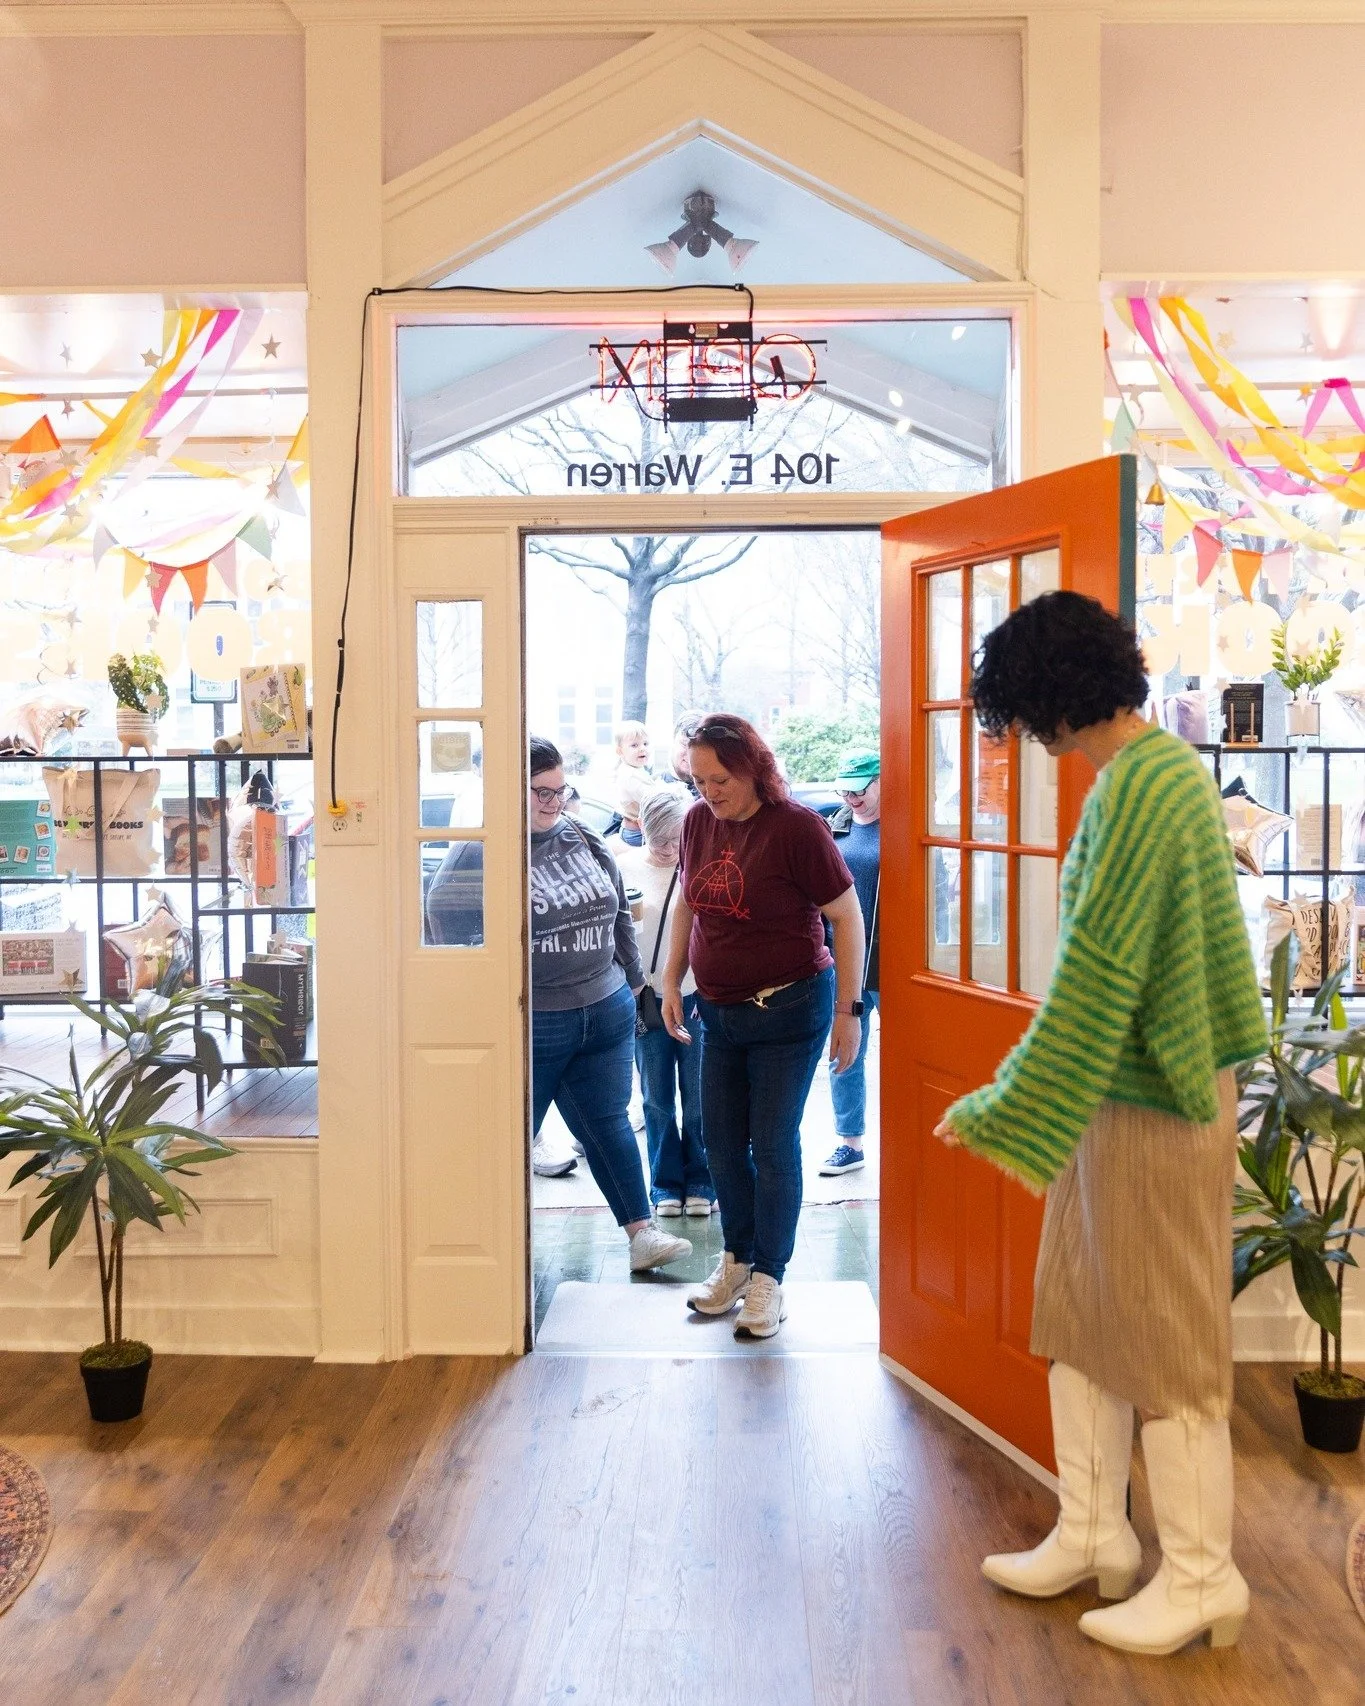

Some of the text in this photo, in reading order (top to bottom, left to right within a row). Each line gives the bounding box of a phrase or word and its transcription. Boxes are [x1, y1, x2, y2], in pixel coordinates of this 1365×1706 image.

[544, 851, 561, 862] THE
[572, 925, 604, 952] JULY
[297, 974, 305, 1015] MYTHOLOGY
